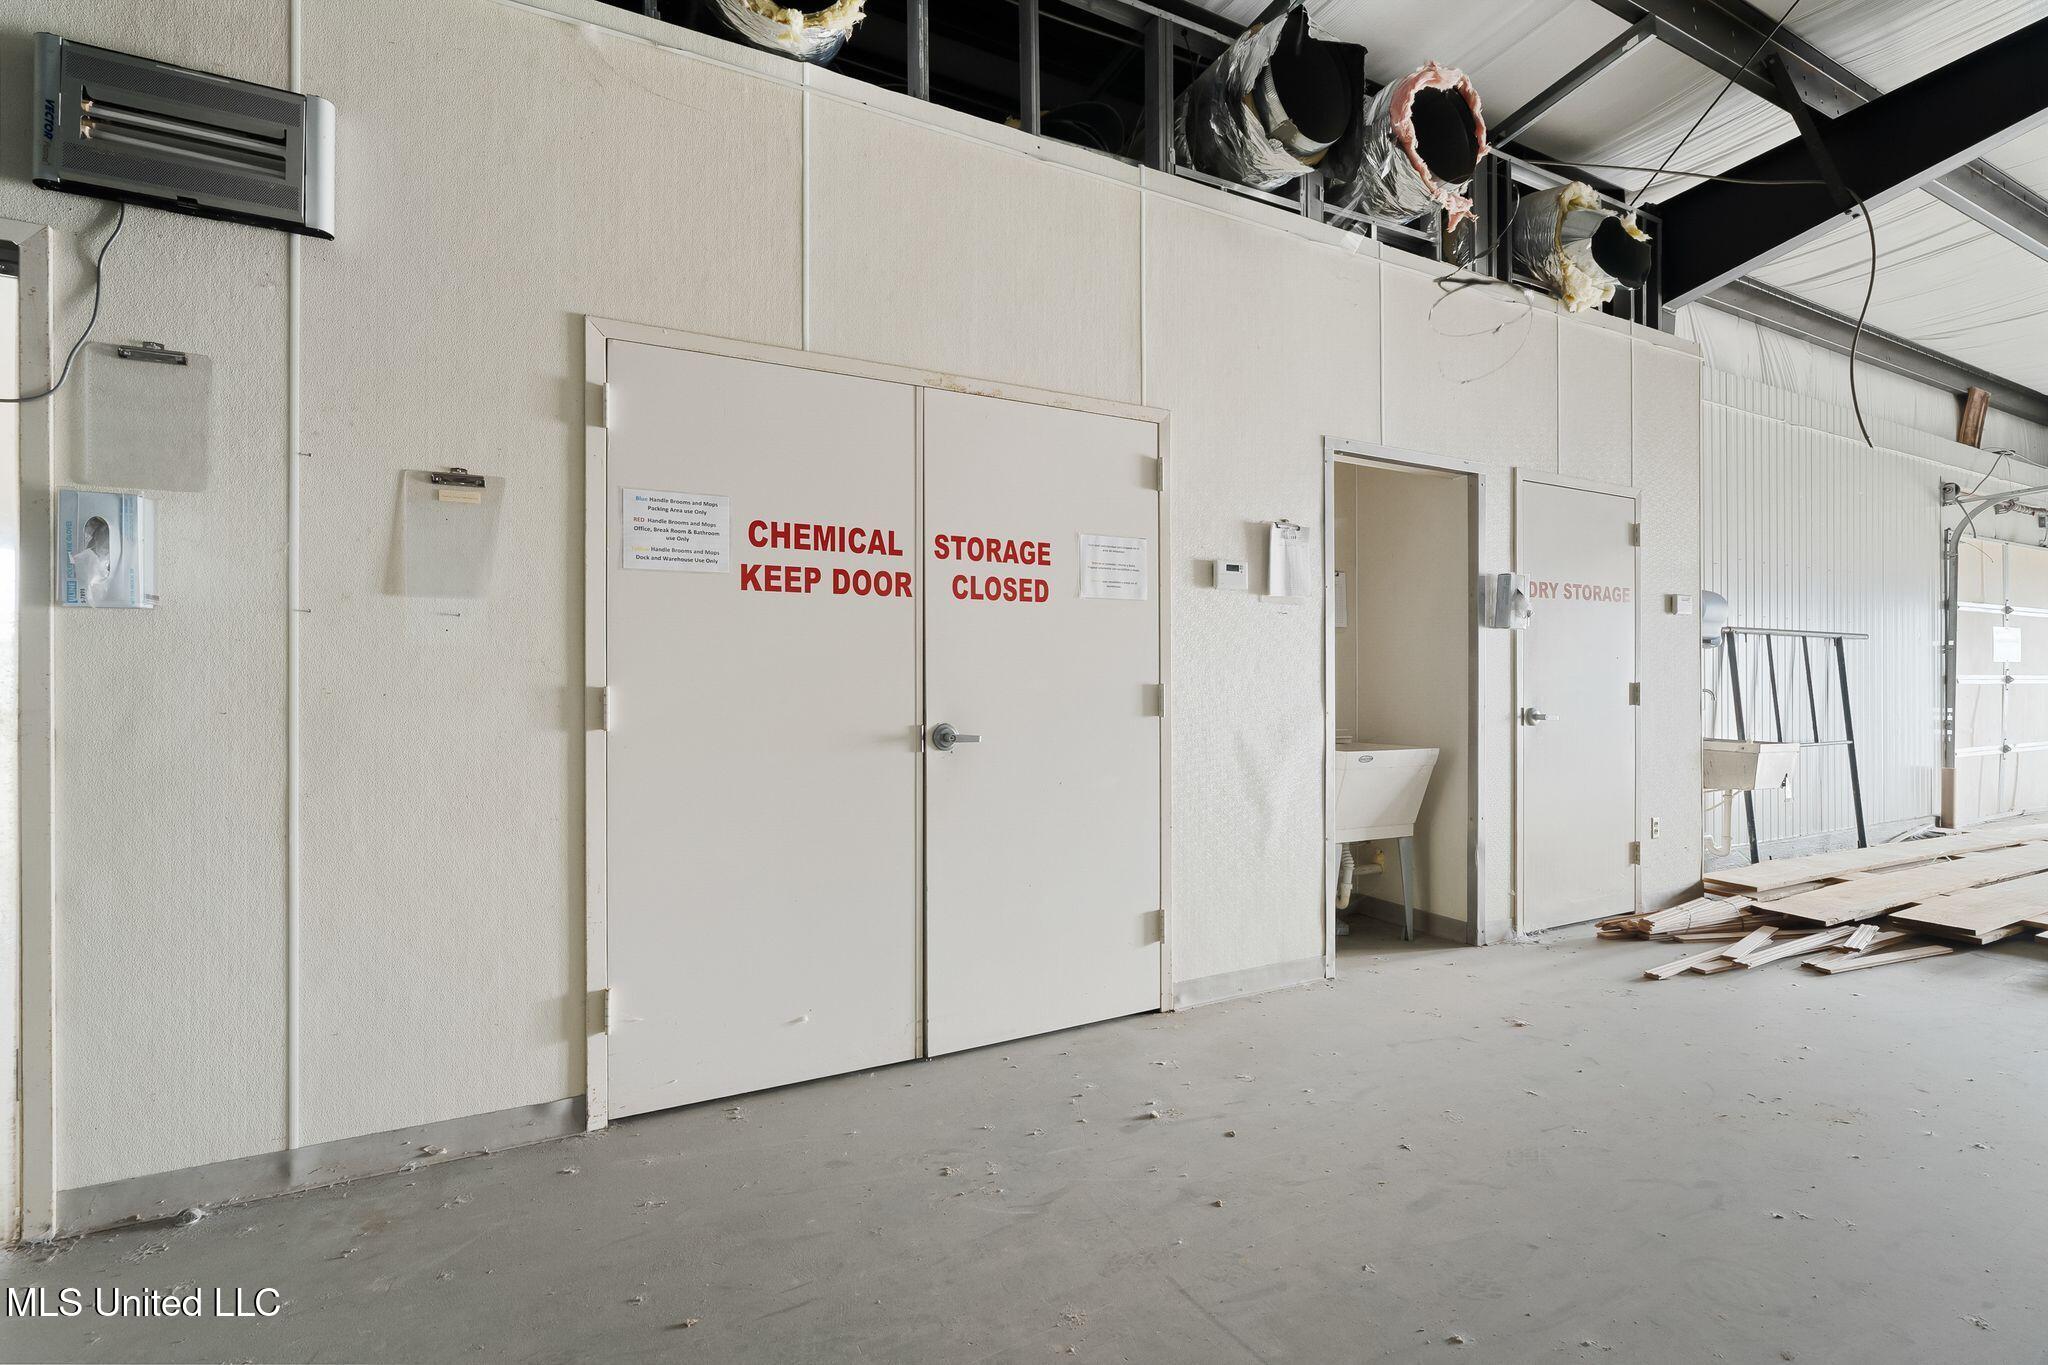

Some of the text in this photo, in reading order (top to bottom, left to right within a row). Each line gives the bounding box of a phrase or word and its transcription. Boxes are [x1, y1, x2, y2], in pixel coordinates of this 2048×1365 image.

[44, 99, 55, 140] VECTOR
[647, 505, 669, 513] Packing
[748, 520, 903, 556] CHEMICAL
[934, 534, 1051, 566] STORAGE
[740, 564, 1049, 603] KEEP DOOR CLOSED
[1529, 581, 1631, 603] DRY STORAGE
